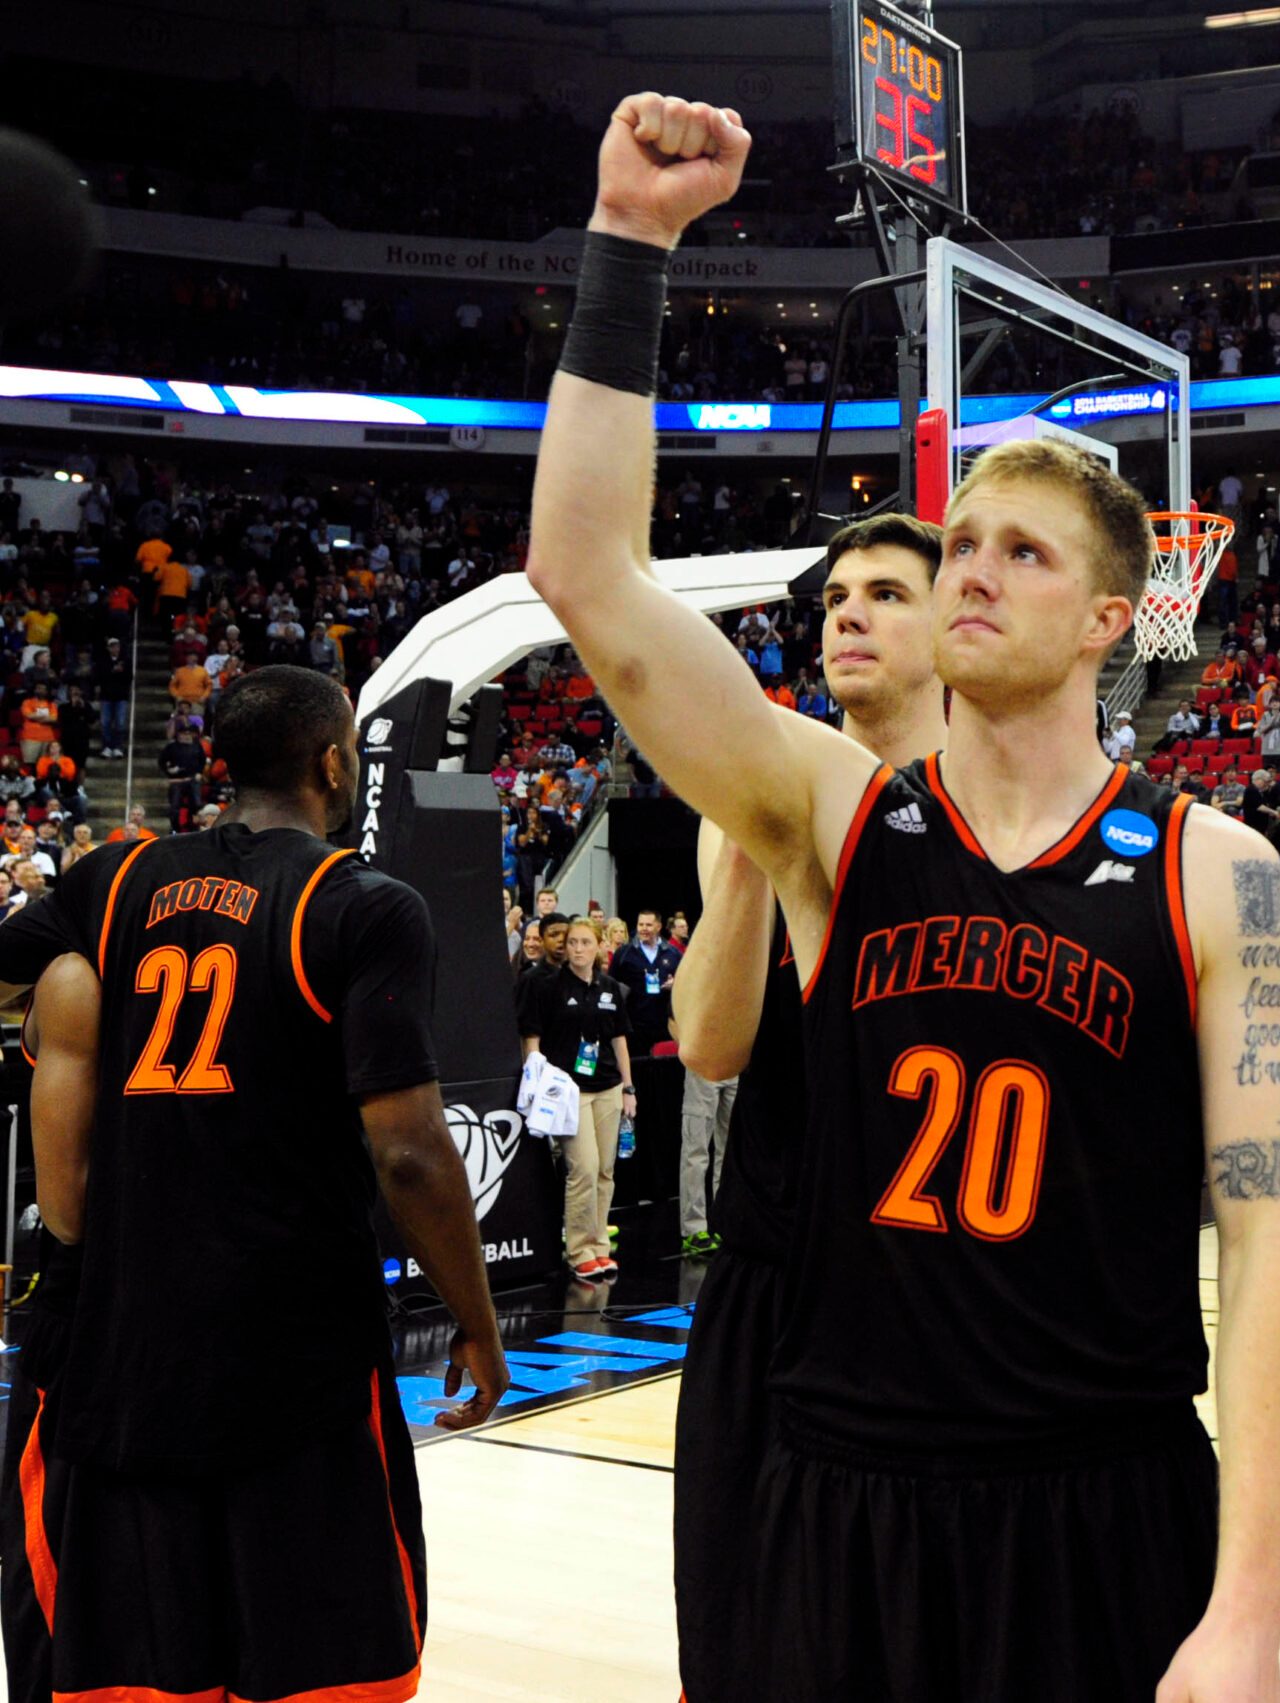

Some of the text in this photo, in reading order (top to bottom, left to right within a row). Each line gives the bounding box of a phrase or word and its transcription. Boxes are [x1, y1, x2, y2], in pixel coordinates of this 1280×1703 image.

[880, 8, 931, 44] DAKTRONICS
[863, 17, 943, 102] 27:00
[875, 76, 936, 184] 35
[386, 246, 456, 268] Home
[466, 253, 489, 270] of
[500, 253, 536, 272] the
[666, 254, 758, 278] olfpack
[457, 429, 477, 440] 114
[884, 813, 927, 834] adidas
[1106, 825, 1153, 849] NCAA
[145, 876, 259, 929] MOTEN
[853, 916, 1134, 1059] MERCER
[123, 943, 235, 1096] 22
[869, 1043, 1051, 1242] 20
